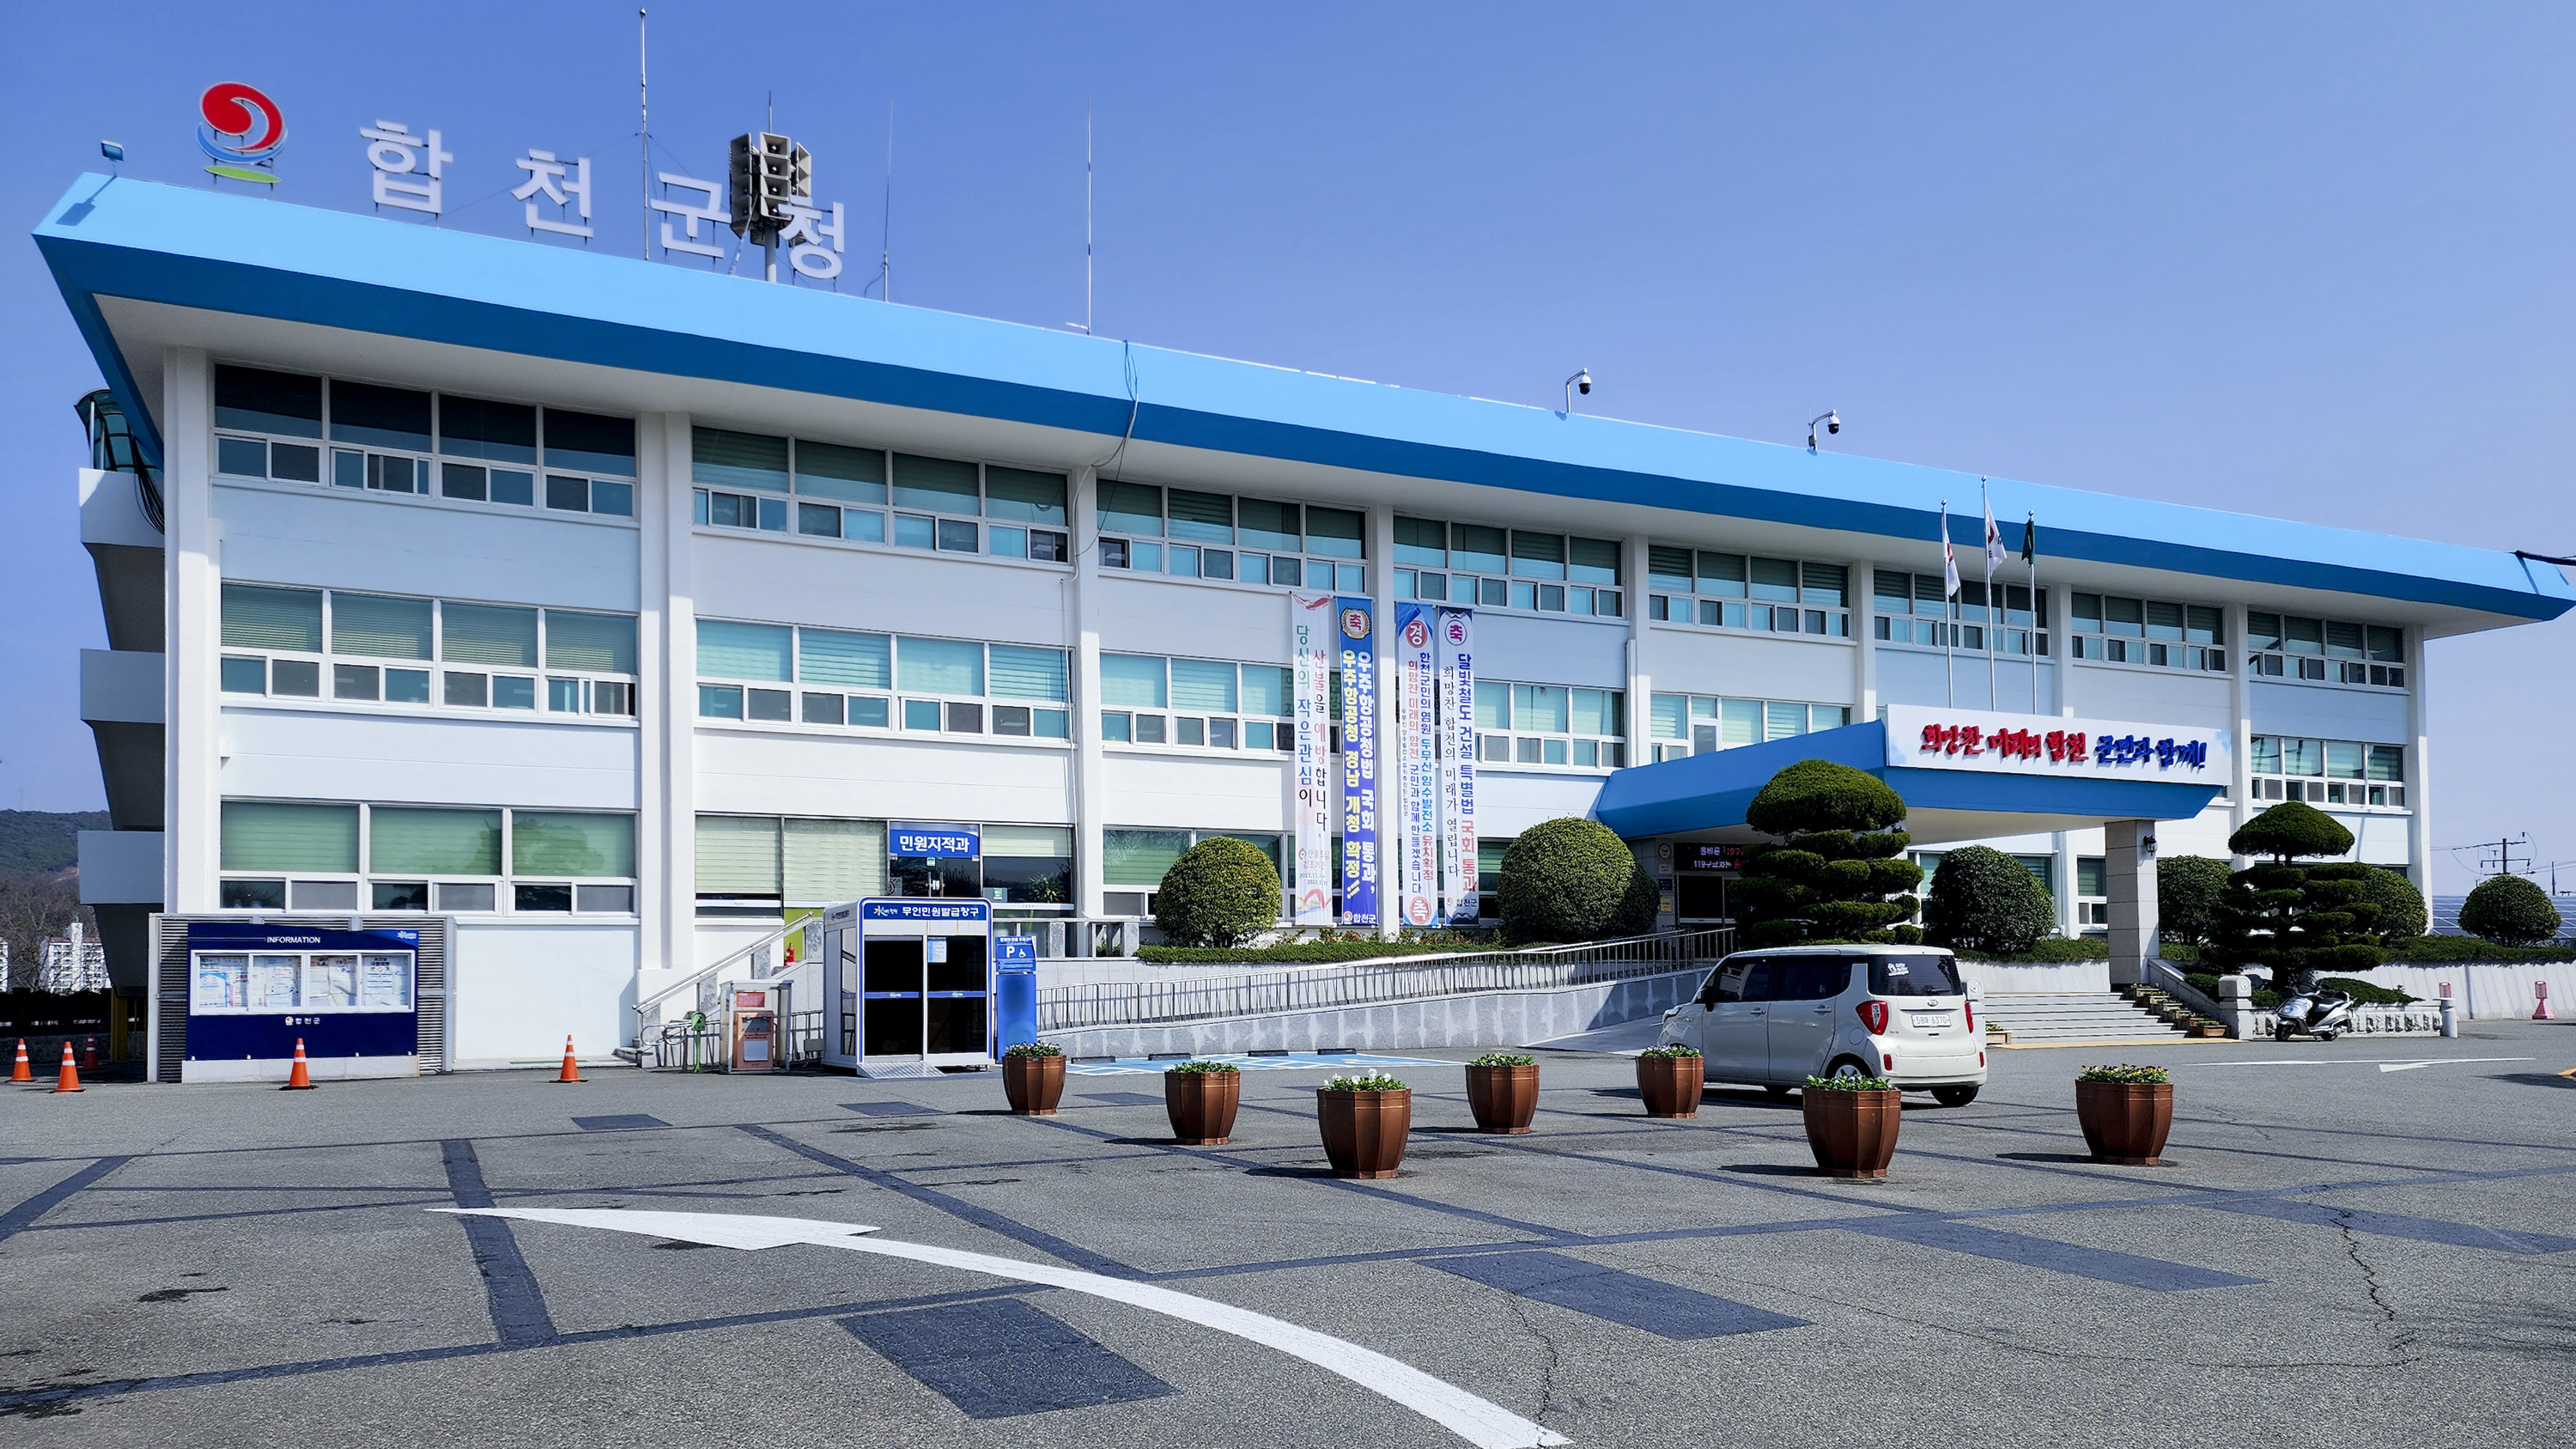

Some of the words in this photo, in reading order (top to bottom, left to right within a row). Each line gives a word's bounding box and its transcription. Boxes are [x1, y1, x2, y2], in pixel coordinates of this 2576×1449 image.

[359, 119, 846, 280] 합천군청
[1349, 613, 1362, 630] 축
[1409, 624, 1423, 645] 경
[1449, 624, 1463, 642] 축
[1297, 624, 1310, 690] 당신의
[1313, 648, 1327, 714] 산불을
[1342, 649, 1358, 743] 우주항공청
[1443, 666, 1456, 710] 희망찬
[1458, 653, 1472, 721] 달빛철도
[1408, 697, 1419, 732] 미래의
[1409, 734, 1419, 759] 합천
[1421, 738, 1432, 773] 두무산
[1443, 716, 1456, 762] 합천의
[1459, 726, 1473, 759] 건설
[1921, 723, 1985, 756] 희망찬
[1987, 728, 2041, 760] 미래의
[2044, 730, 2089, 762] 합천
[2094, 734, 2154, 764] 군민과
[2154, 738, 2208, 773] 함께!
[1345, 750, 1360, 788] 경남
[1410, 764, 1420, 798] 군민과
[1421, 775, 1433, 832] 양수발전소
[1444, 767, 1459, 813] 미래가
[1460, 764, 1474, 815] 특별법
[1346, 795, 1361, 833] 개청
[1361, 788, 1375, 832] 국회
[1410, 801, 1420, 823] 함께
[899, 835, 970, 853] 민원지적과
[1446, 818, 1461, 878] 열립니다
[1461, 819, 1475, 854] 국회
[1462, 858, 1477, 892] 통과
[902, 906, 979, 917] 무인민원발급창구
[1353, 912, 1376, 924] 합천군
[1412, 899, 1429, 921] 축
[1455, 898, 1478, 908] 합천군
[1006, 946, 1016, 959] P
[1931, 1016, 1947, 1025] 6370
